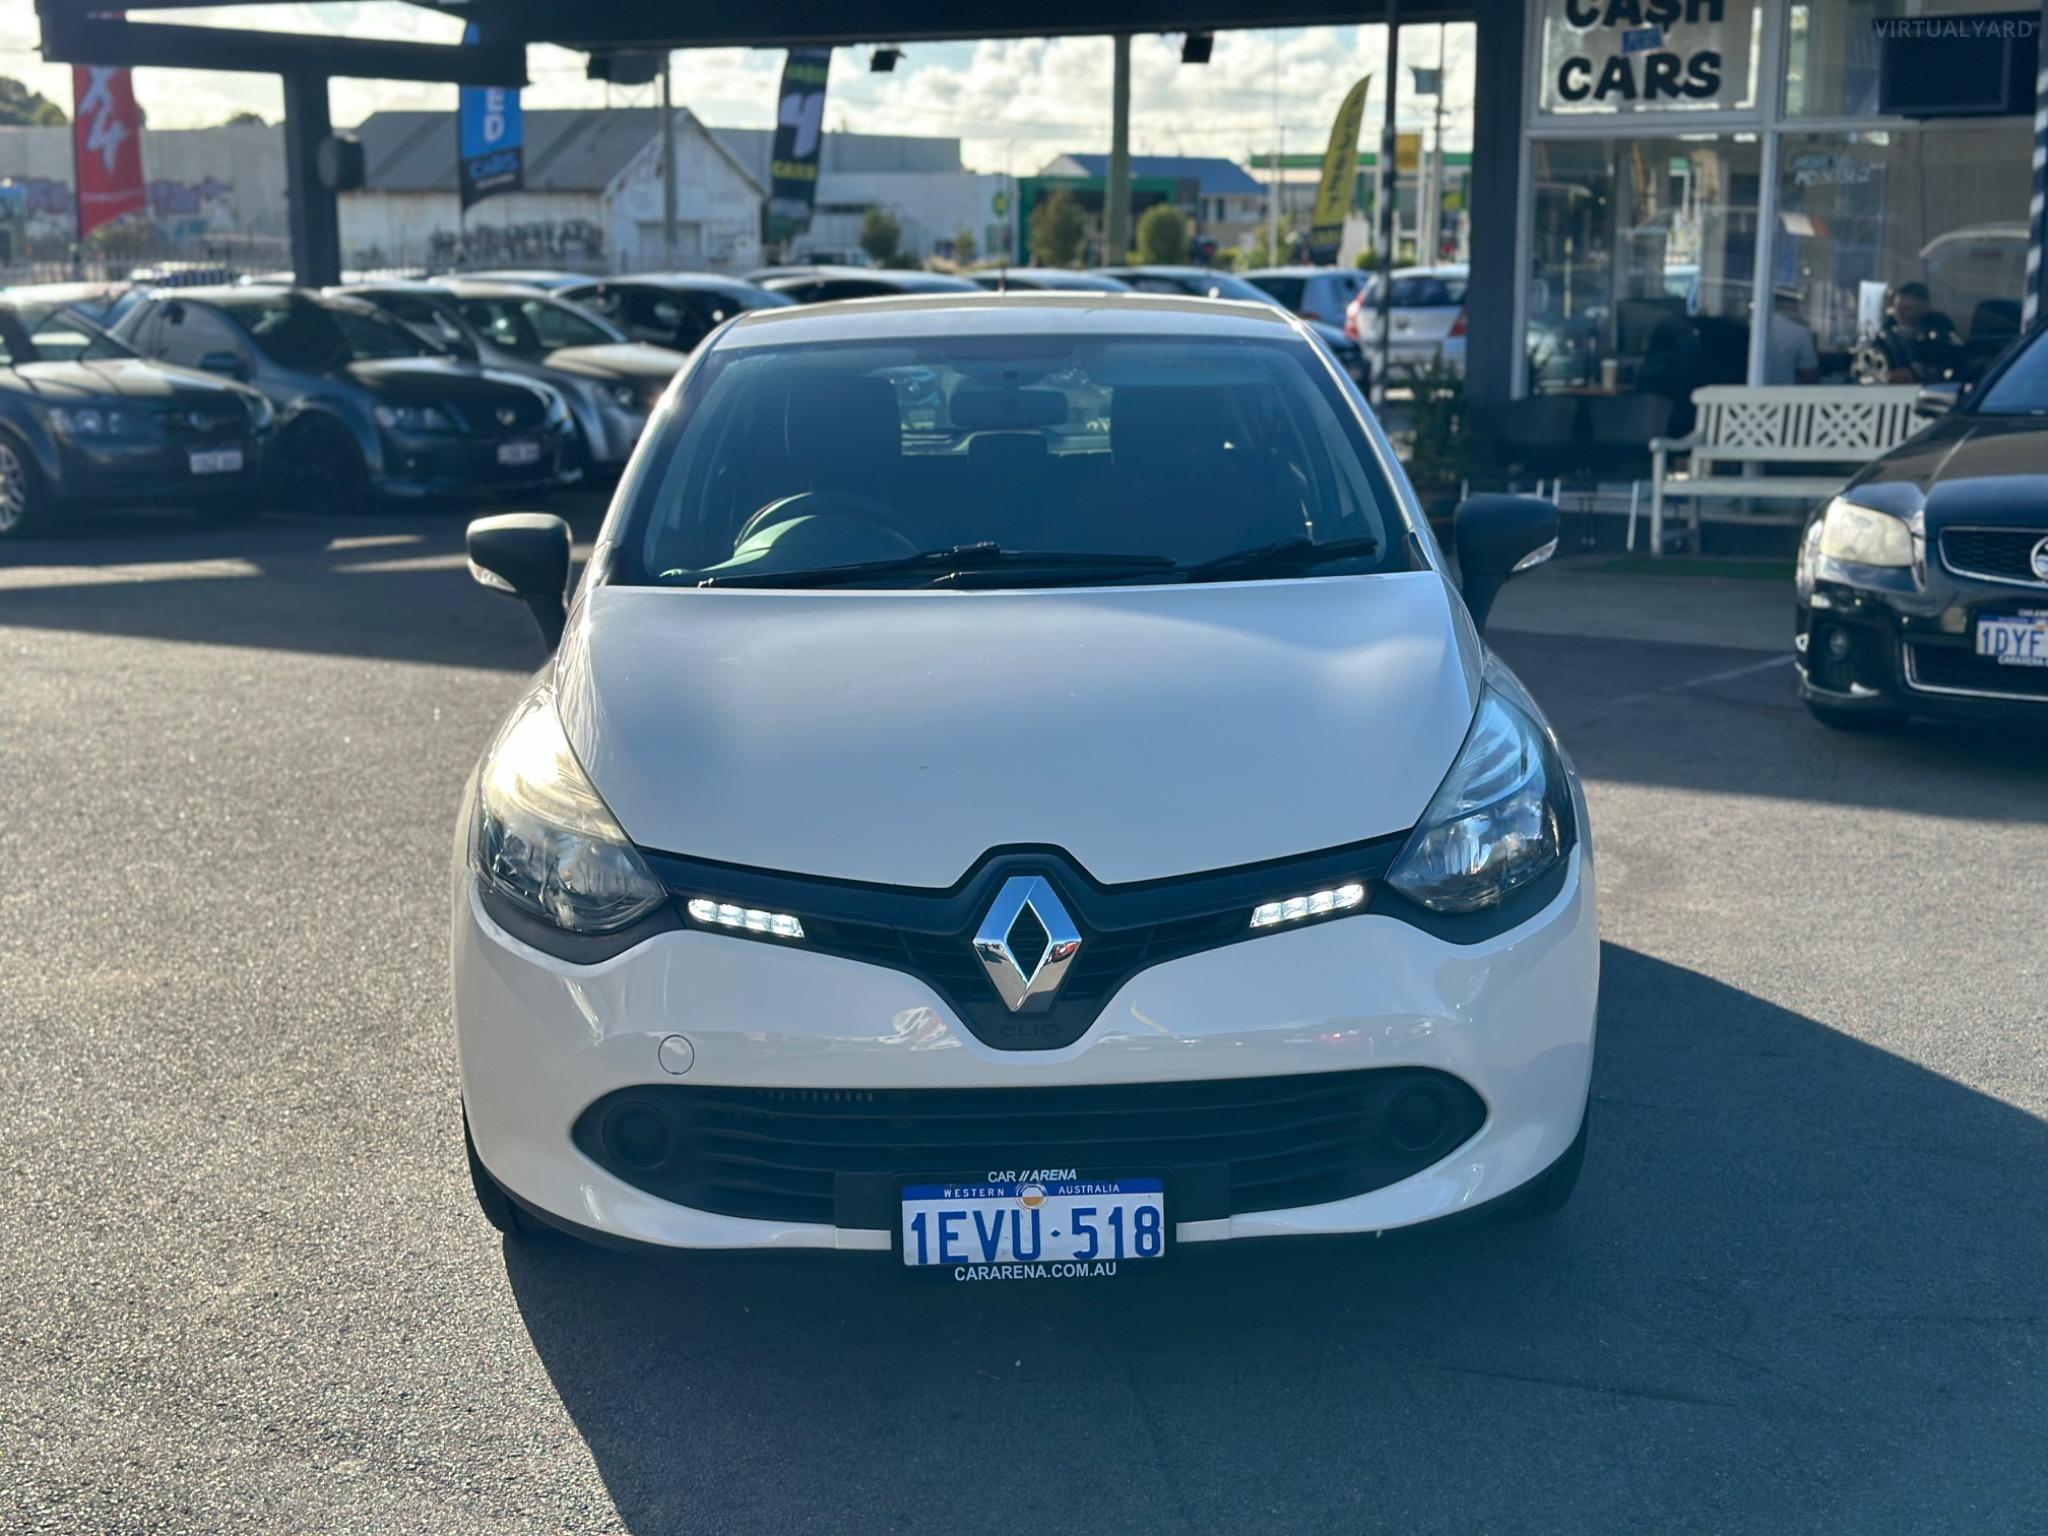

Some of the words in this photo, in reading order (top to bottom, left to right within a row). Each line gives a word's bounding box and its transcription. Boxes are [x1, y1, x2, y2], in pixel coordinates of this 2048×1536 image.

[1558, 50, 1721, 101] CARS
[1000, 1023, 1062, 1038] CLIO
[988, 1171, 1016, 1183] CAR
[943, 1188, 1005, 1198] WESTERN
[1058, 1184, 1121, 1195] AUSTRALIA
[954, 1262, 1117, 1282] CARARENA.COM.AU
